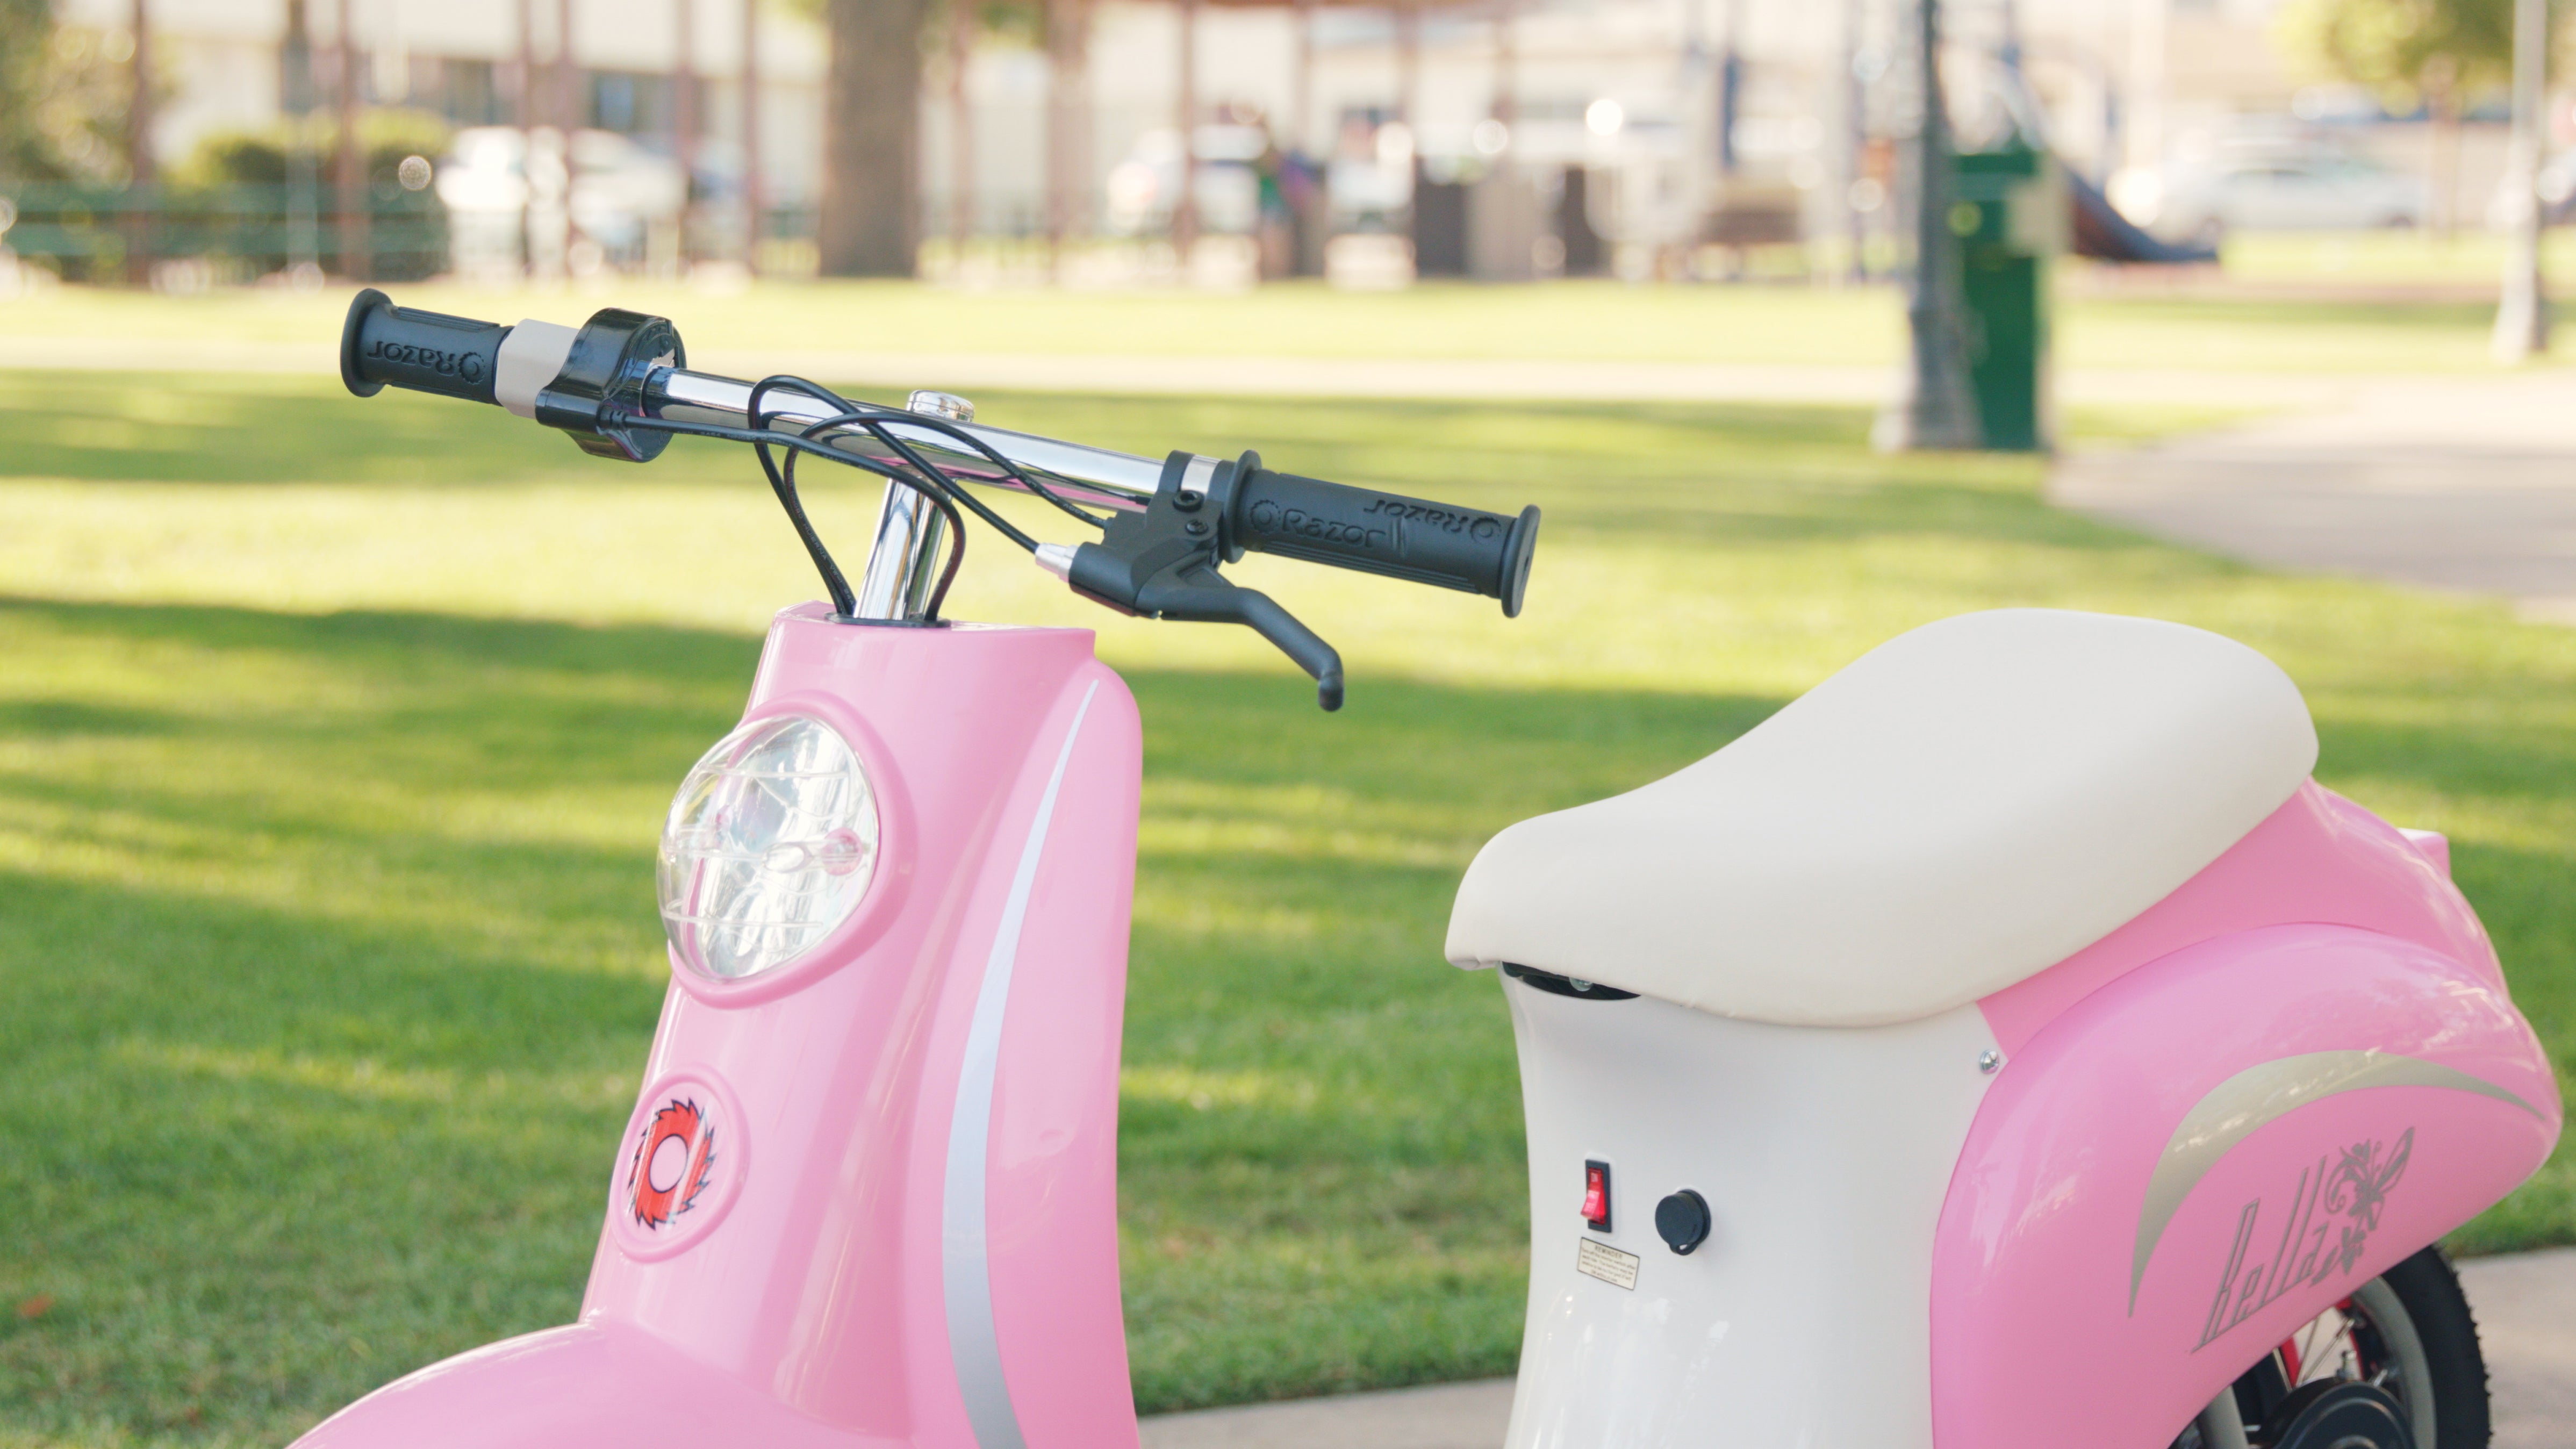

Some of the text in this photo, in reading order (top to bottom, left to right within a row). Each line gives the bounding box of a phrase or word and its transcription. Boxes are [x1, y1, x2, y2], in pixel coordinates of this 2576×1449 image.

[367, 340, 456, 376] Razor
[1282, 508, 1387, 548] Razor
[1364, 499, 1469, 533] Razor
